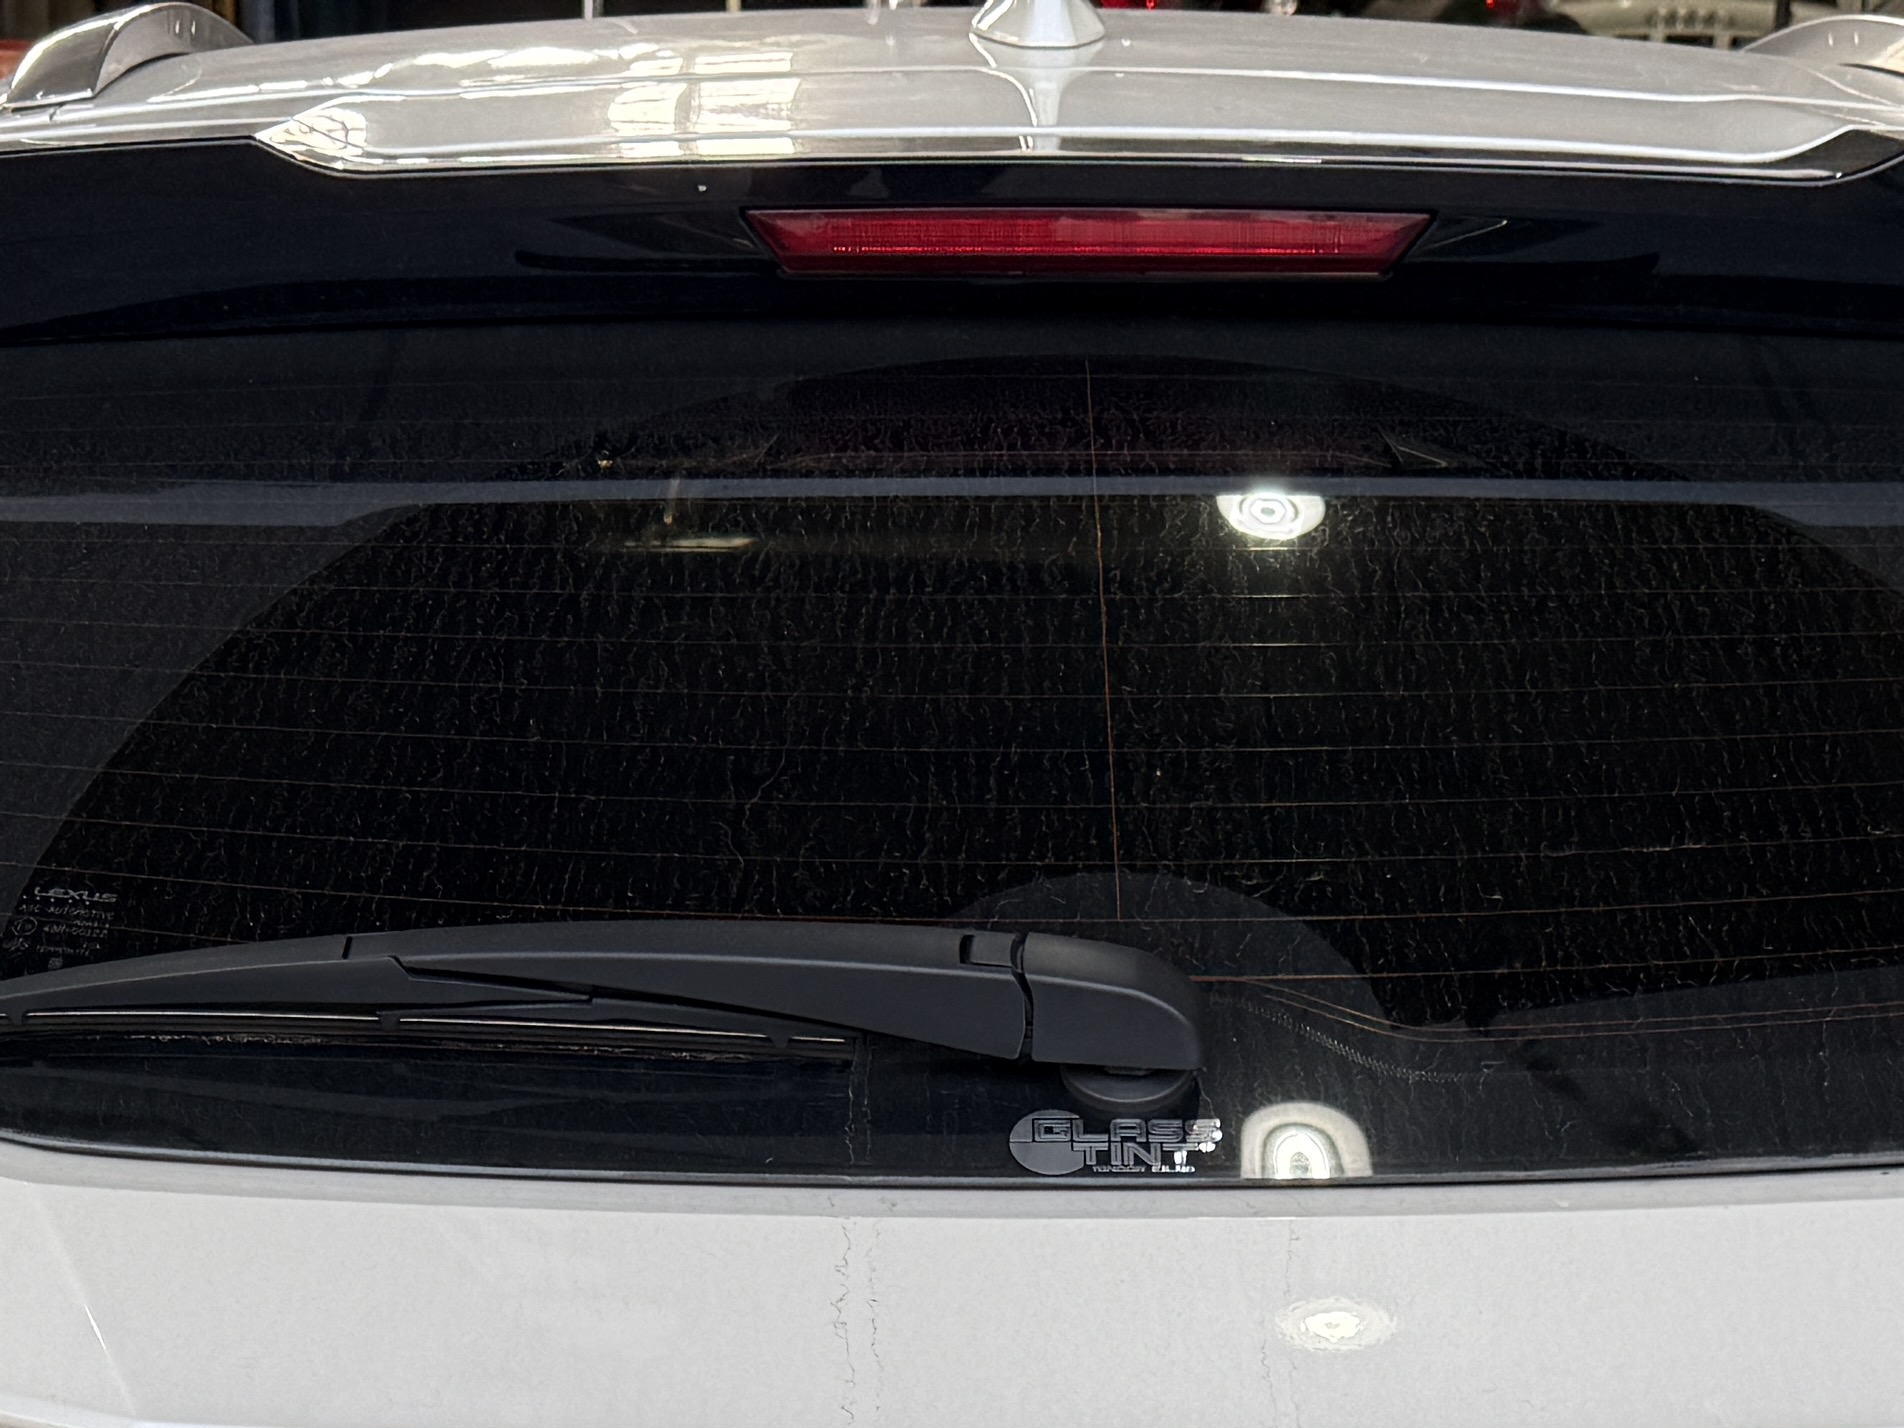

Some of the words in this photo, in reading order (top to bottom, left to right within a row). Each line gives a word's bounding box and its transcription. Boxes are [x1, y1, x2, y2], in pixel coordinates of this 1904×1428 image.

[34, 886, 118, 903] LEXUS
[1034, 1118, 1223, 1142] GLASS
[1073, 1142, 1202, 1166] TINT
